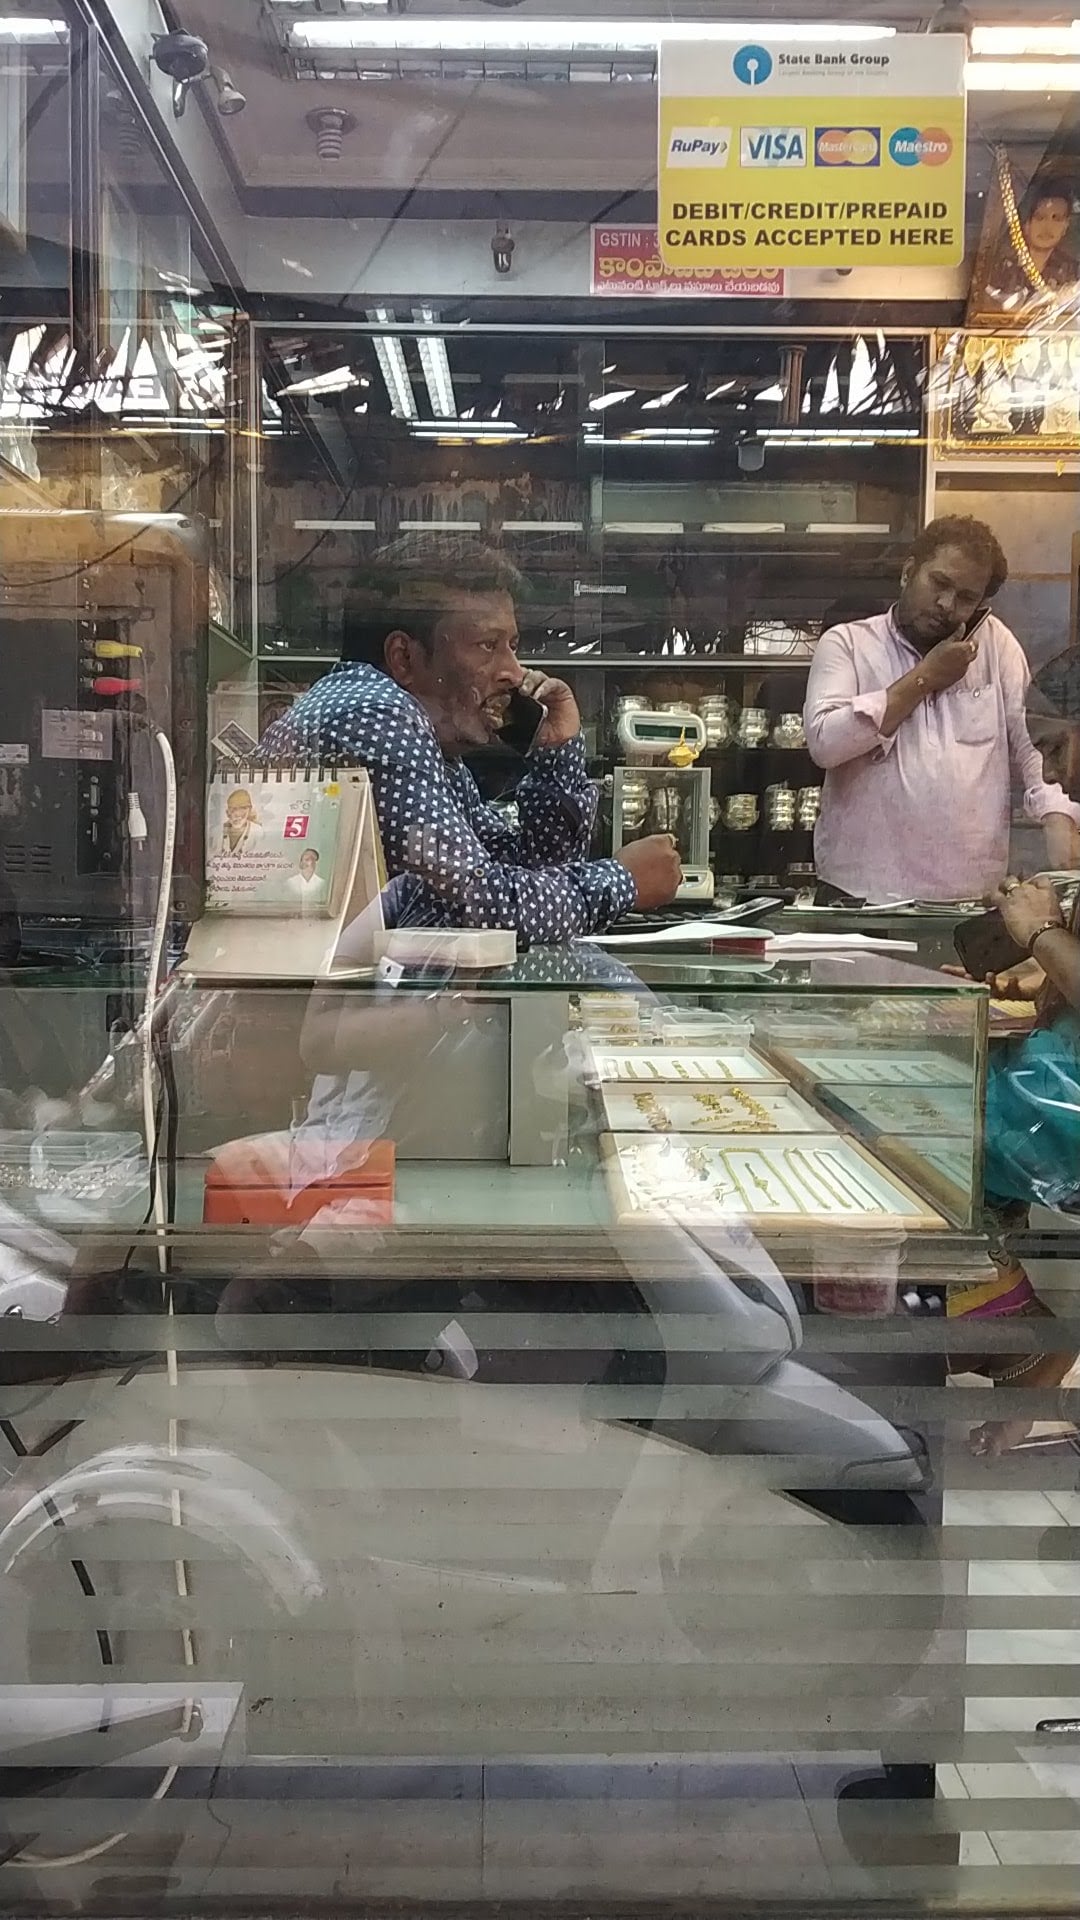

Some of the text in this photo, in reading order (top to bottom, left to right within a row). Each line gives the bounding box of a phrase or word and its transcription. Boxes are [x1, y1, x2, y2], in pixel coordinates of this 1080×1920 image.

[778, 53, 890, 67] State Bank Group
[671, 138, 721, 155] RuPay
[748, 134, 804, 160] VISA
[893, 140, 948, 153] Maestro
[672, 202, 948, 220] DEBIT/CREDIT/PREPAID
[600, 232, 641, 247] GSTIN
[665, 229, 747, 246] CARDS
[754, 229, 881, 246] ACCEPTED
[889, 229, 954, 246] HERE
[289, 817, 304, 838] 5
